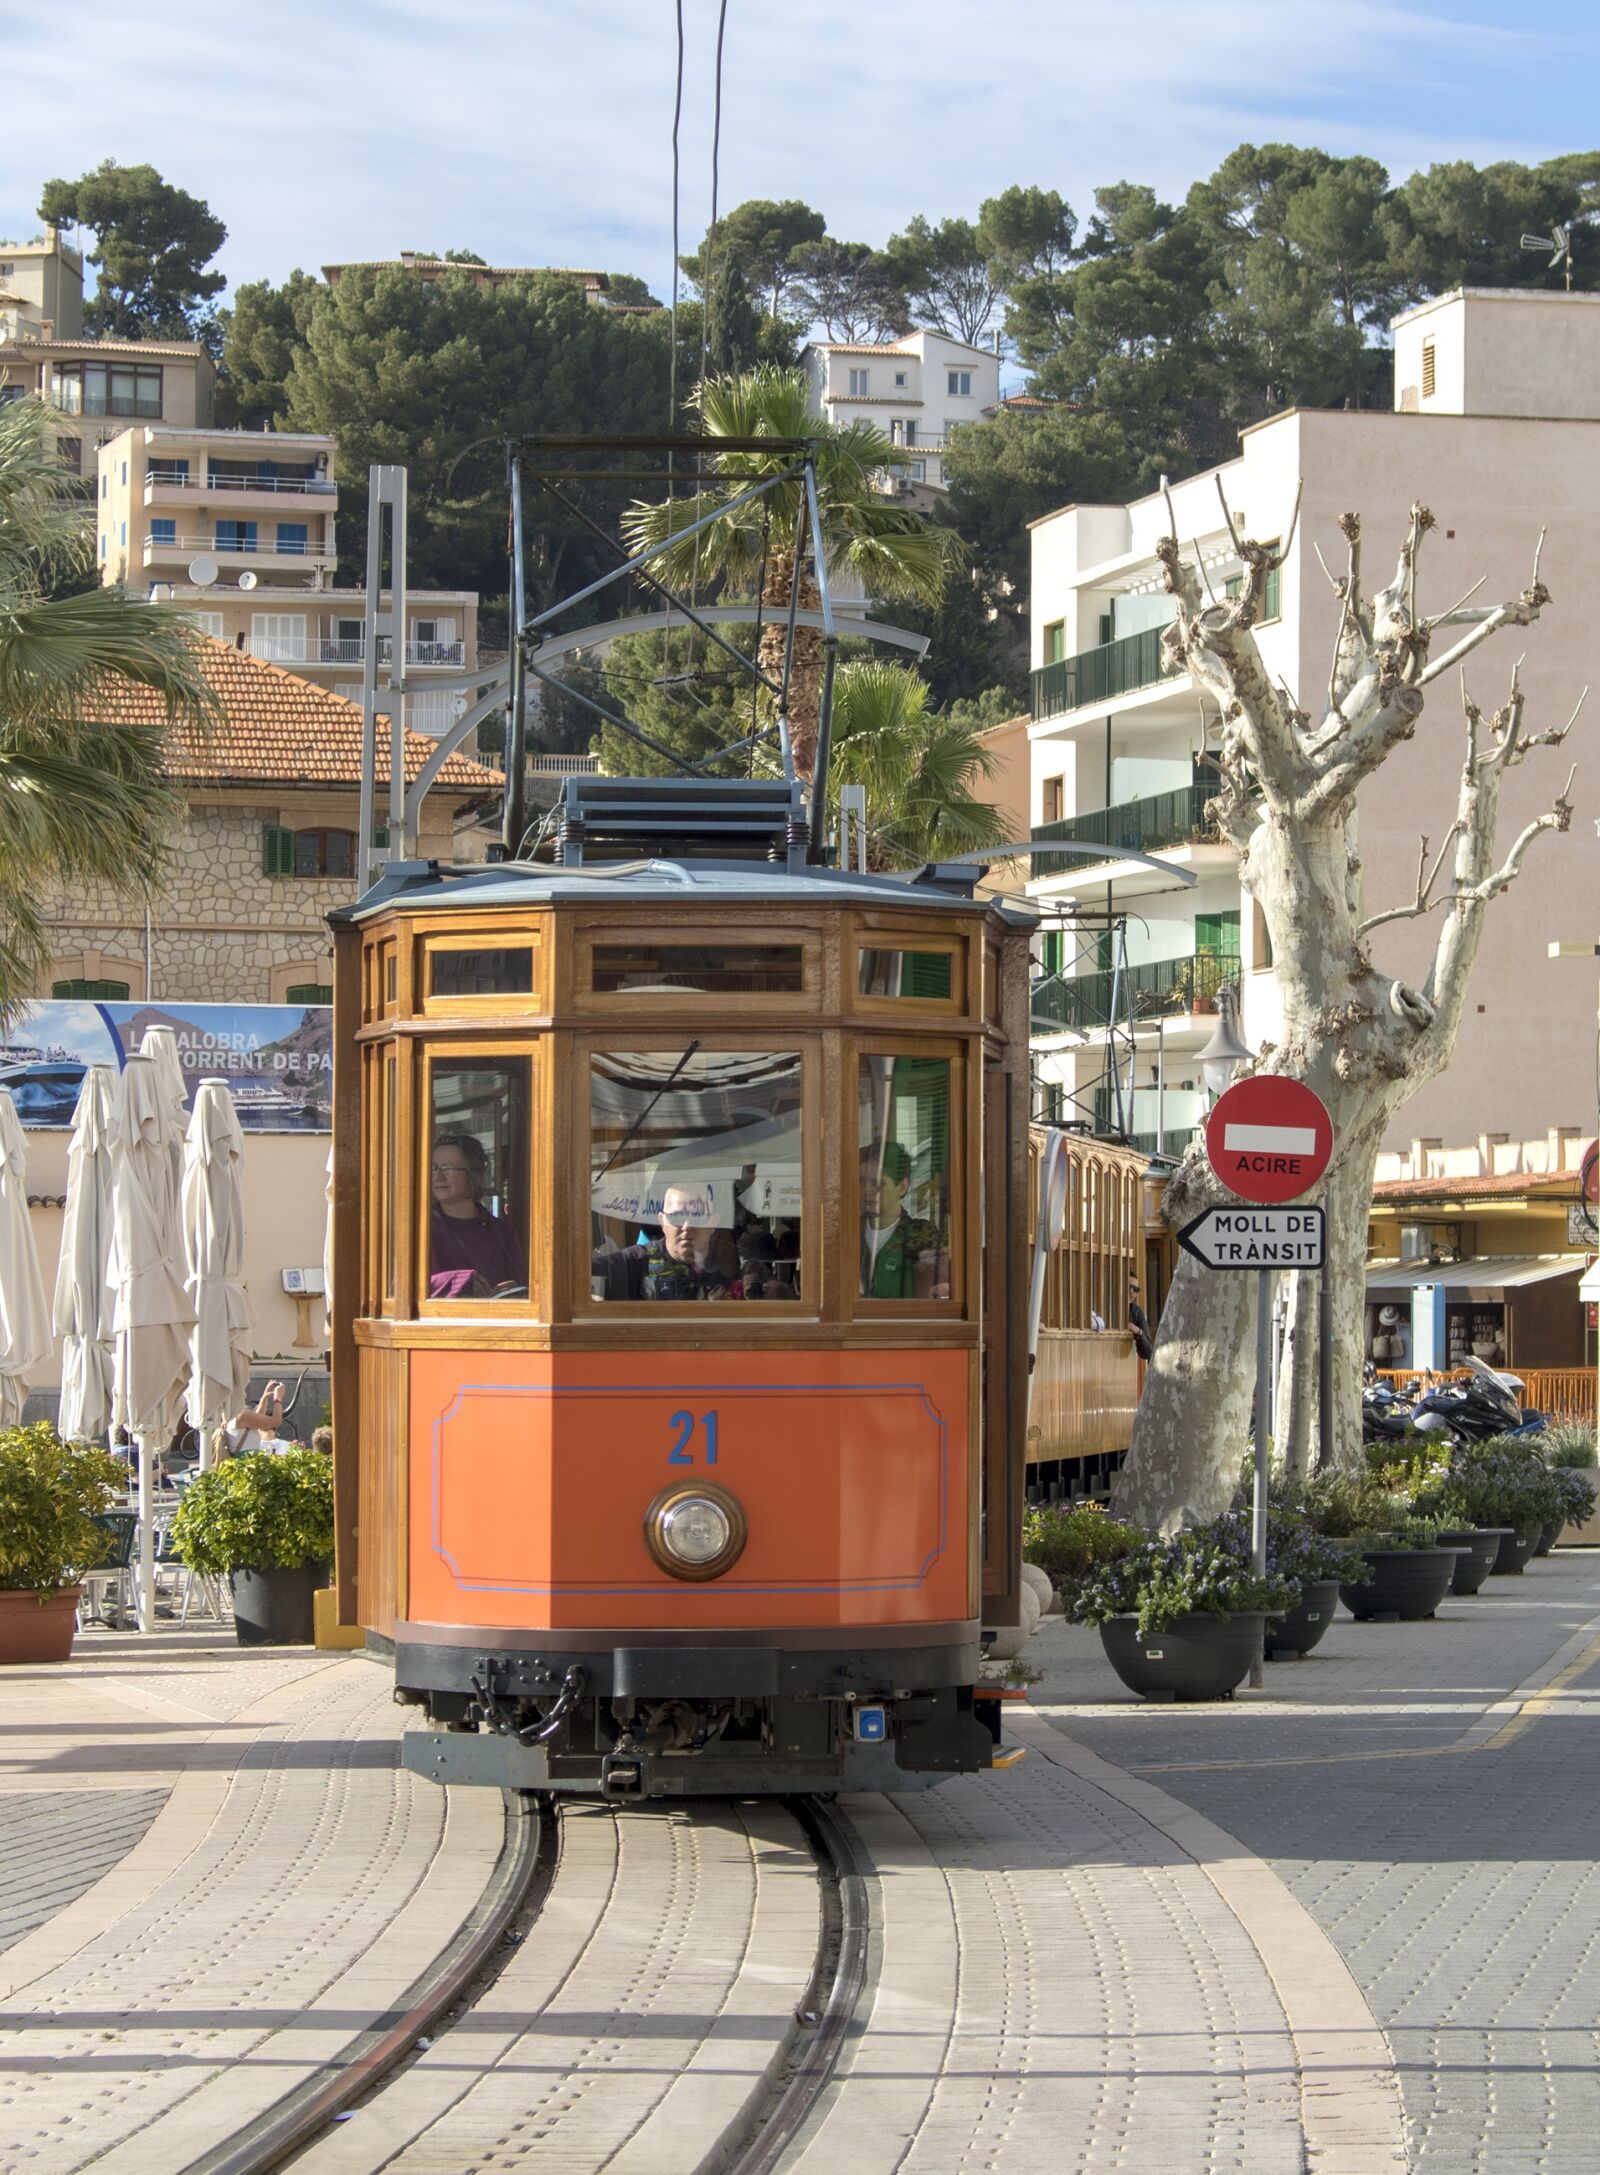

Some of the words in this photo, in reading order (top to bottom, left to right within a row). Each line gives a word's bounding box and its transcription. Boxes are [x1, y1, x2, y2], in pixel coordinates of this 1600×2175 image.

[177, 1031, 260, 1050] ALOBRA
[273, 1052, 301, 1070] DE
[1236, 1156, 1301, 1175] ACIRE
[1215, 1216, 1276, 1233] MOLL
[1287, 1216, 1316, 1233] DE
[1214, 1238, 1317, 1260] TRÀNSIT
[668, 1410, 718, 1465] 21
